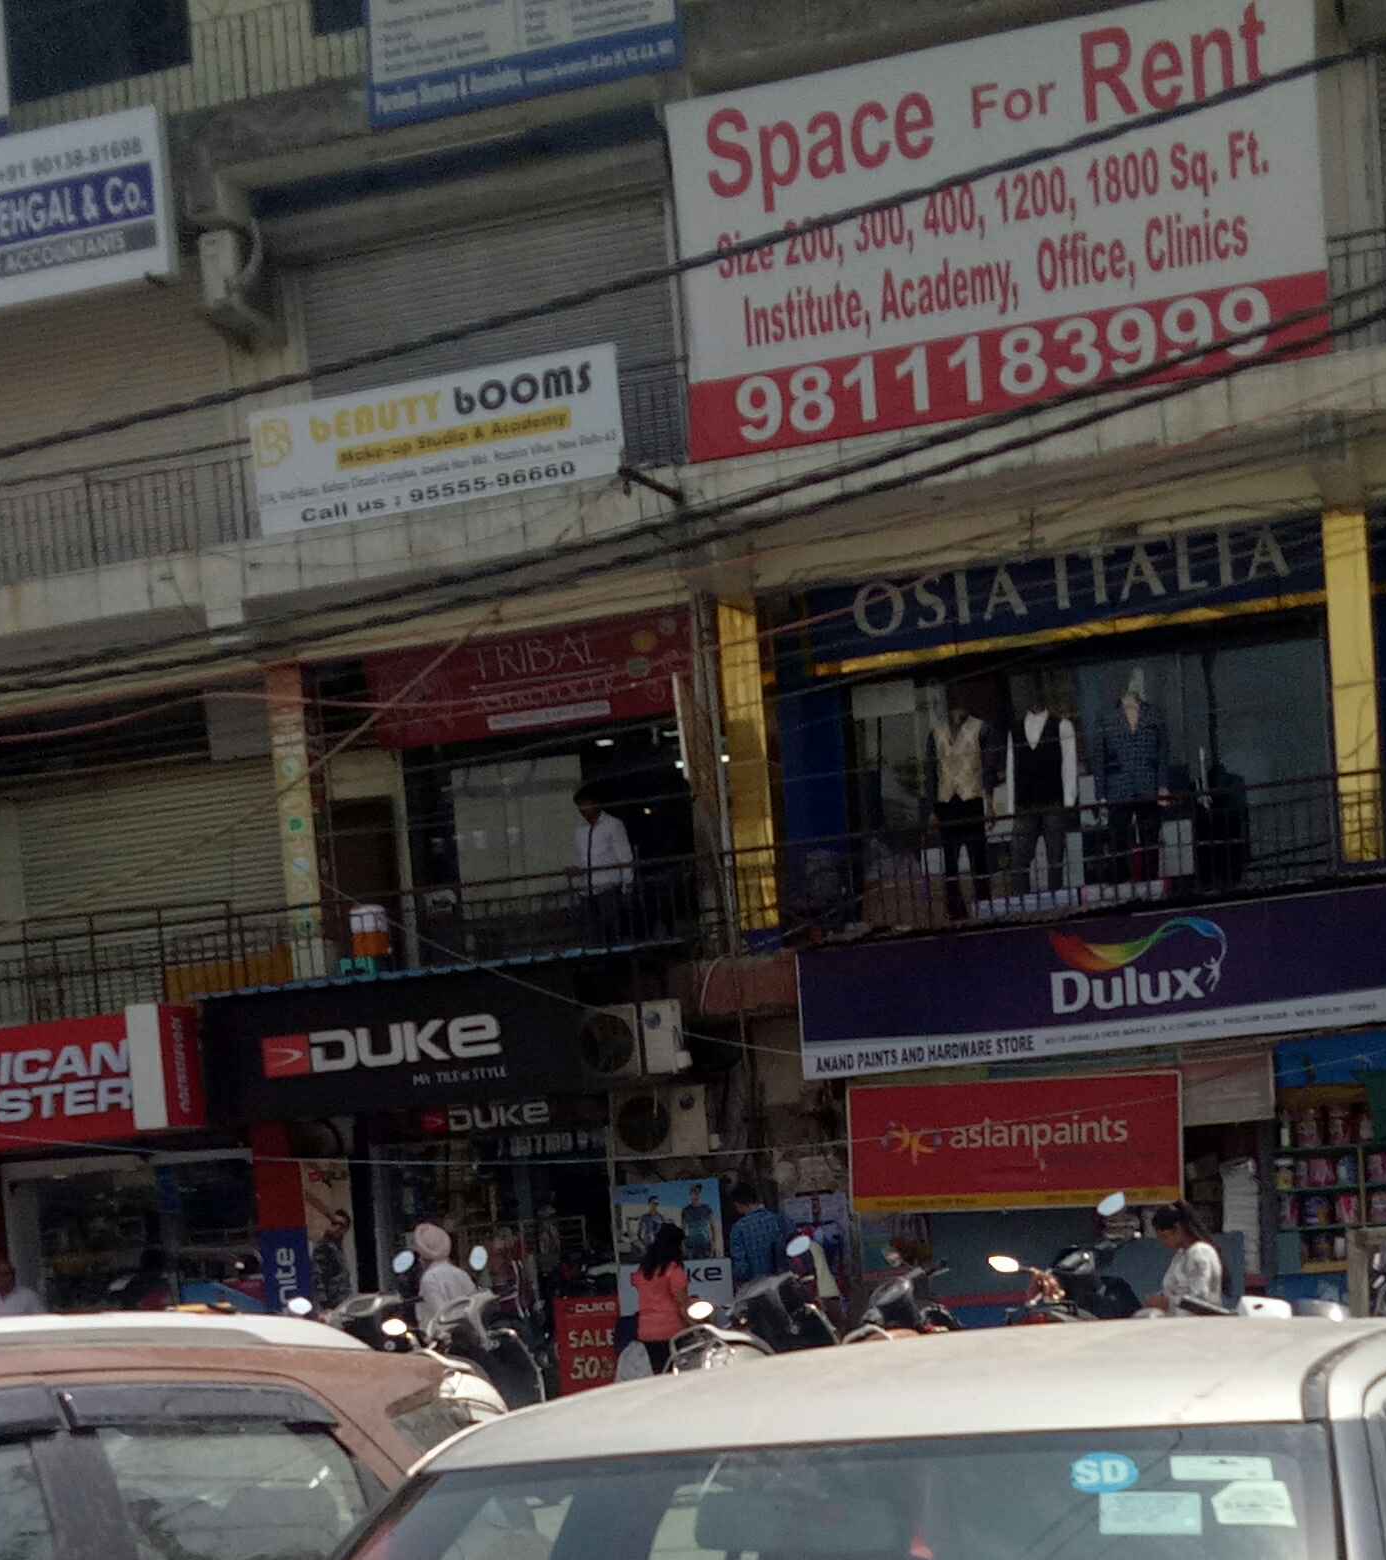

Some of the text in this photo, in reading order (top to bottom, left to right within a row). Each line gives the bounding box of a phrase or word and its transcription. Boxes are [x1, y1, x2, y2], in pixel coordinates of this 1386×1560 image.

[705, 2, 1267, 212] Space For Rent
[82, 183, 100, 221] &
[103, 176, 147, 214] Co.
[715, 129, 1270, 281] Size 200, 300, 400, 1200, 1800 Sq. Ft.
[2, 229, 127, 277] ACCOUNTANTS
[742, 212, 1250, 348] Institute, Academy, Office, Clinics
[734, 286, 1274, 445] 9811183999
[338, 437, 413, 465] Make-up
[416, 427, 471, 452] Studio
[301, 502, 348, 524] Call
[357, 496, 387, 516] us
[409, 459, 578, 504] 95555-96660
[853, 560, 1030, 639] OSIA
[476, 632, 601, 682] TRIBAL
[1050, 965, 1206, 1016] Dulux
[815, 1034, 1034, 1074] ANAND PAINTS AND HARDWARE STORE
[948, 1113, 1129, 1160] asianpaints
[568, 1327, 615, 1349] SALE
[1073, 1459, 1129, 1485] SD
